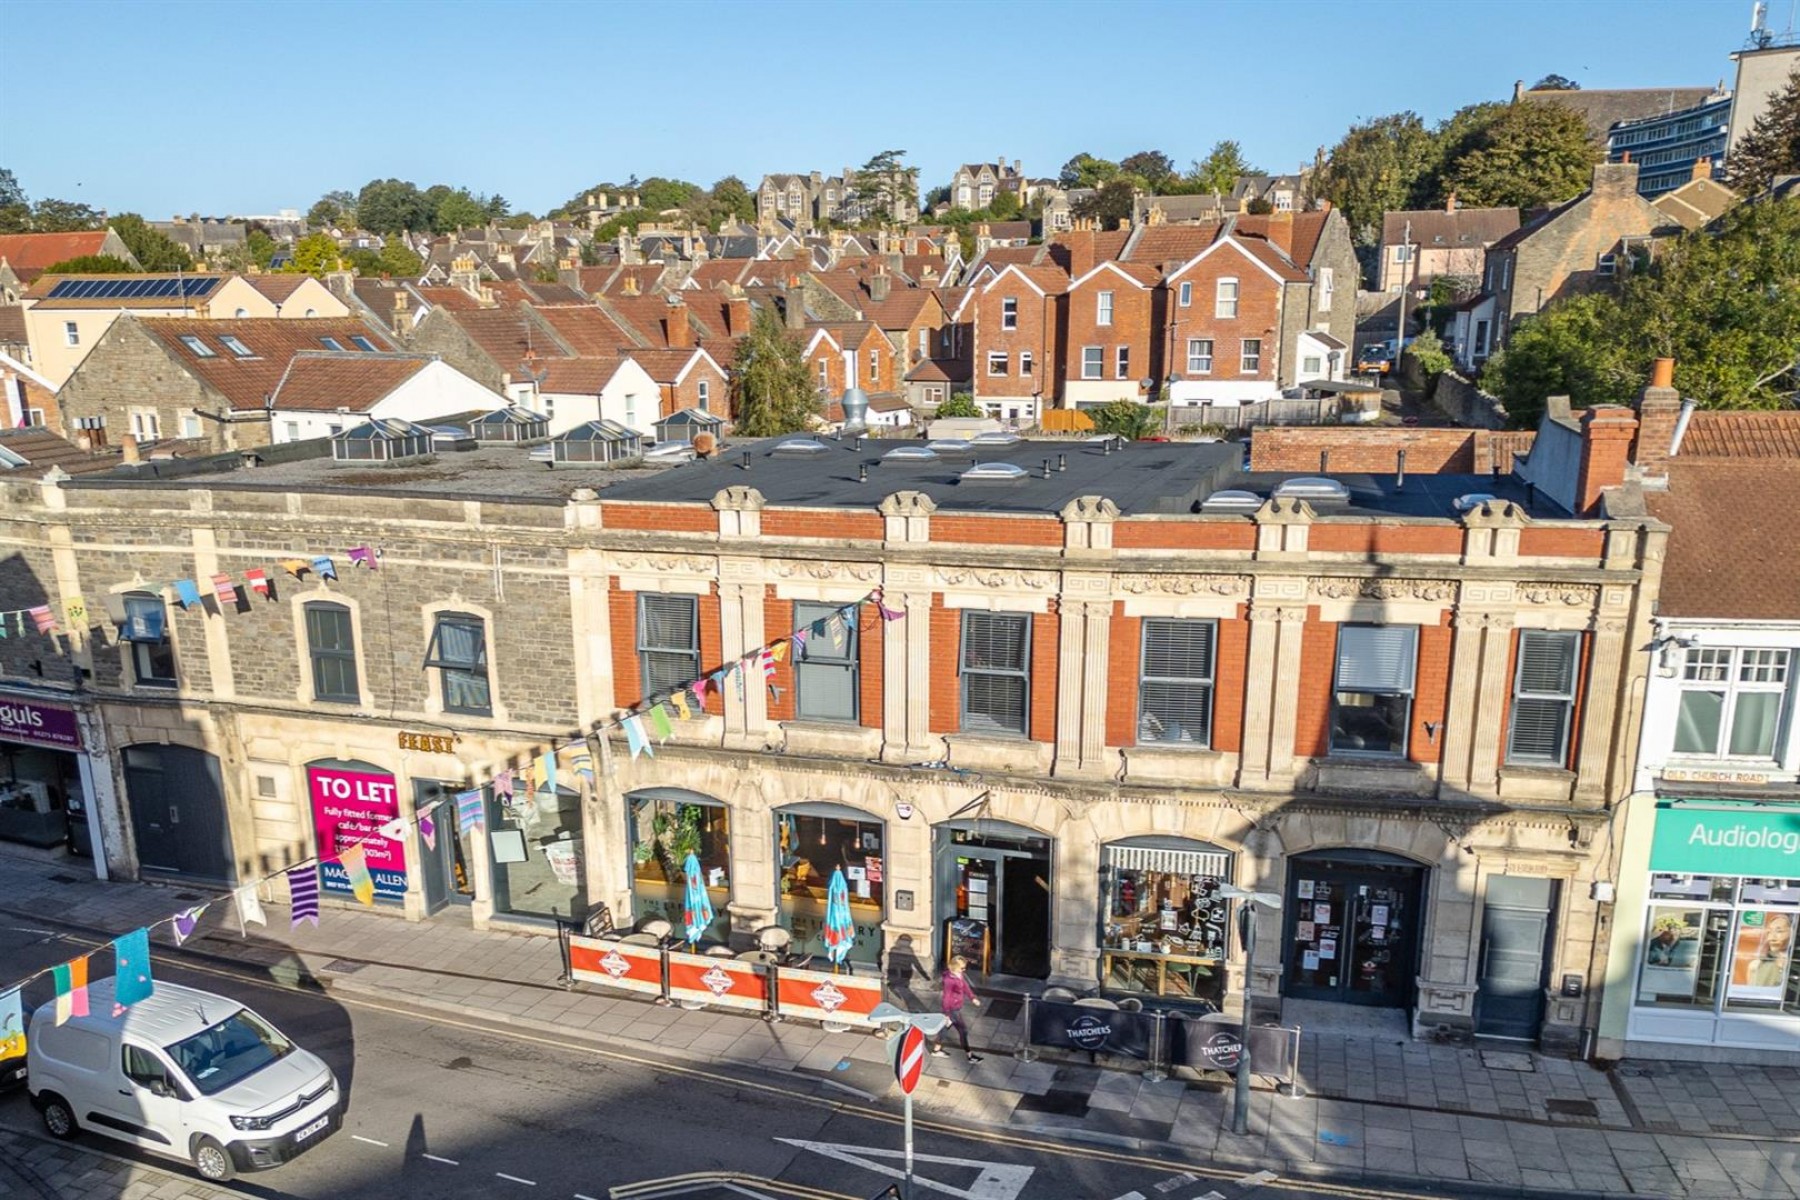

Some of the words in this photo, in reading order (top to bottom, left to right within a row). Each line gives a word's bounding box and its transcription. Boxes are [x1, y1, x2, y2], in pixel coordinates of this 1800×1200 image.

[0, 705, 43, 727] guls
[399, 731, 455, 753] FEAST
[1667, 770, 1687, 779] OLD
[1692, 771, 1732, 780] CHURCH
[1737, 773, 1764, 782] ROAD
[317, 776, 351, 799] TO
[356, 781, 394, 804] LET
[324, 806, 342, 818] Fully
[375, 873, 409, 887] ALLEN
[1066, 1025, 1112, 1038] THATCHERS
[1201, 1043, 1242, 1056] THATCHER
